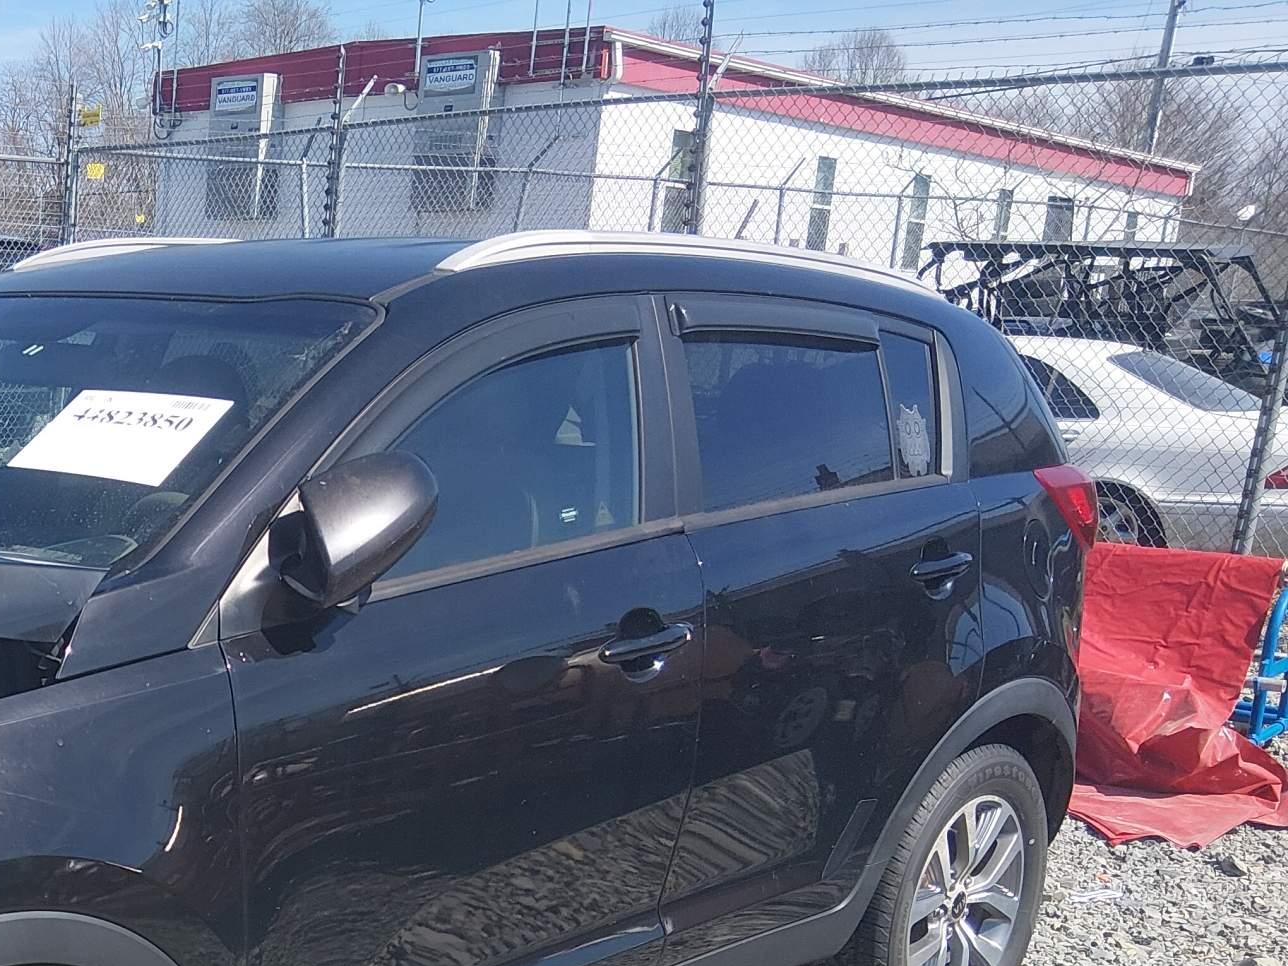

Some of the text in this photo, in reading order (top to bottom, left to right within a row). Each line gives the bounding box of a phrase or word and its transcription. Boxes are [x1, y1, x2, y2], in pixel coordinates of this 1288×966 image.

[427, 73, 475, 84] VANGUARD
[217, 94, 256, 104] VANGUARD
[73, 407, 194, 431] 44823850
